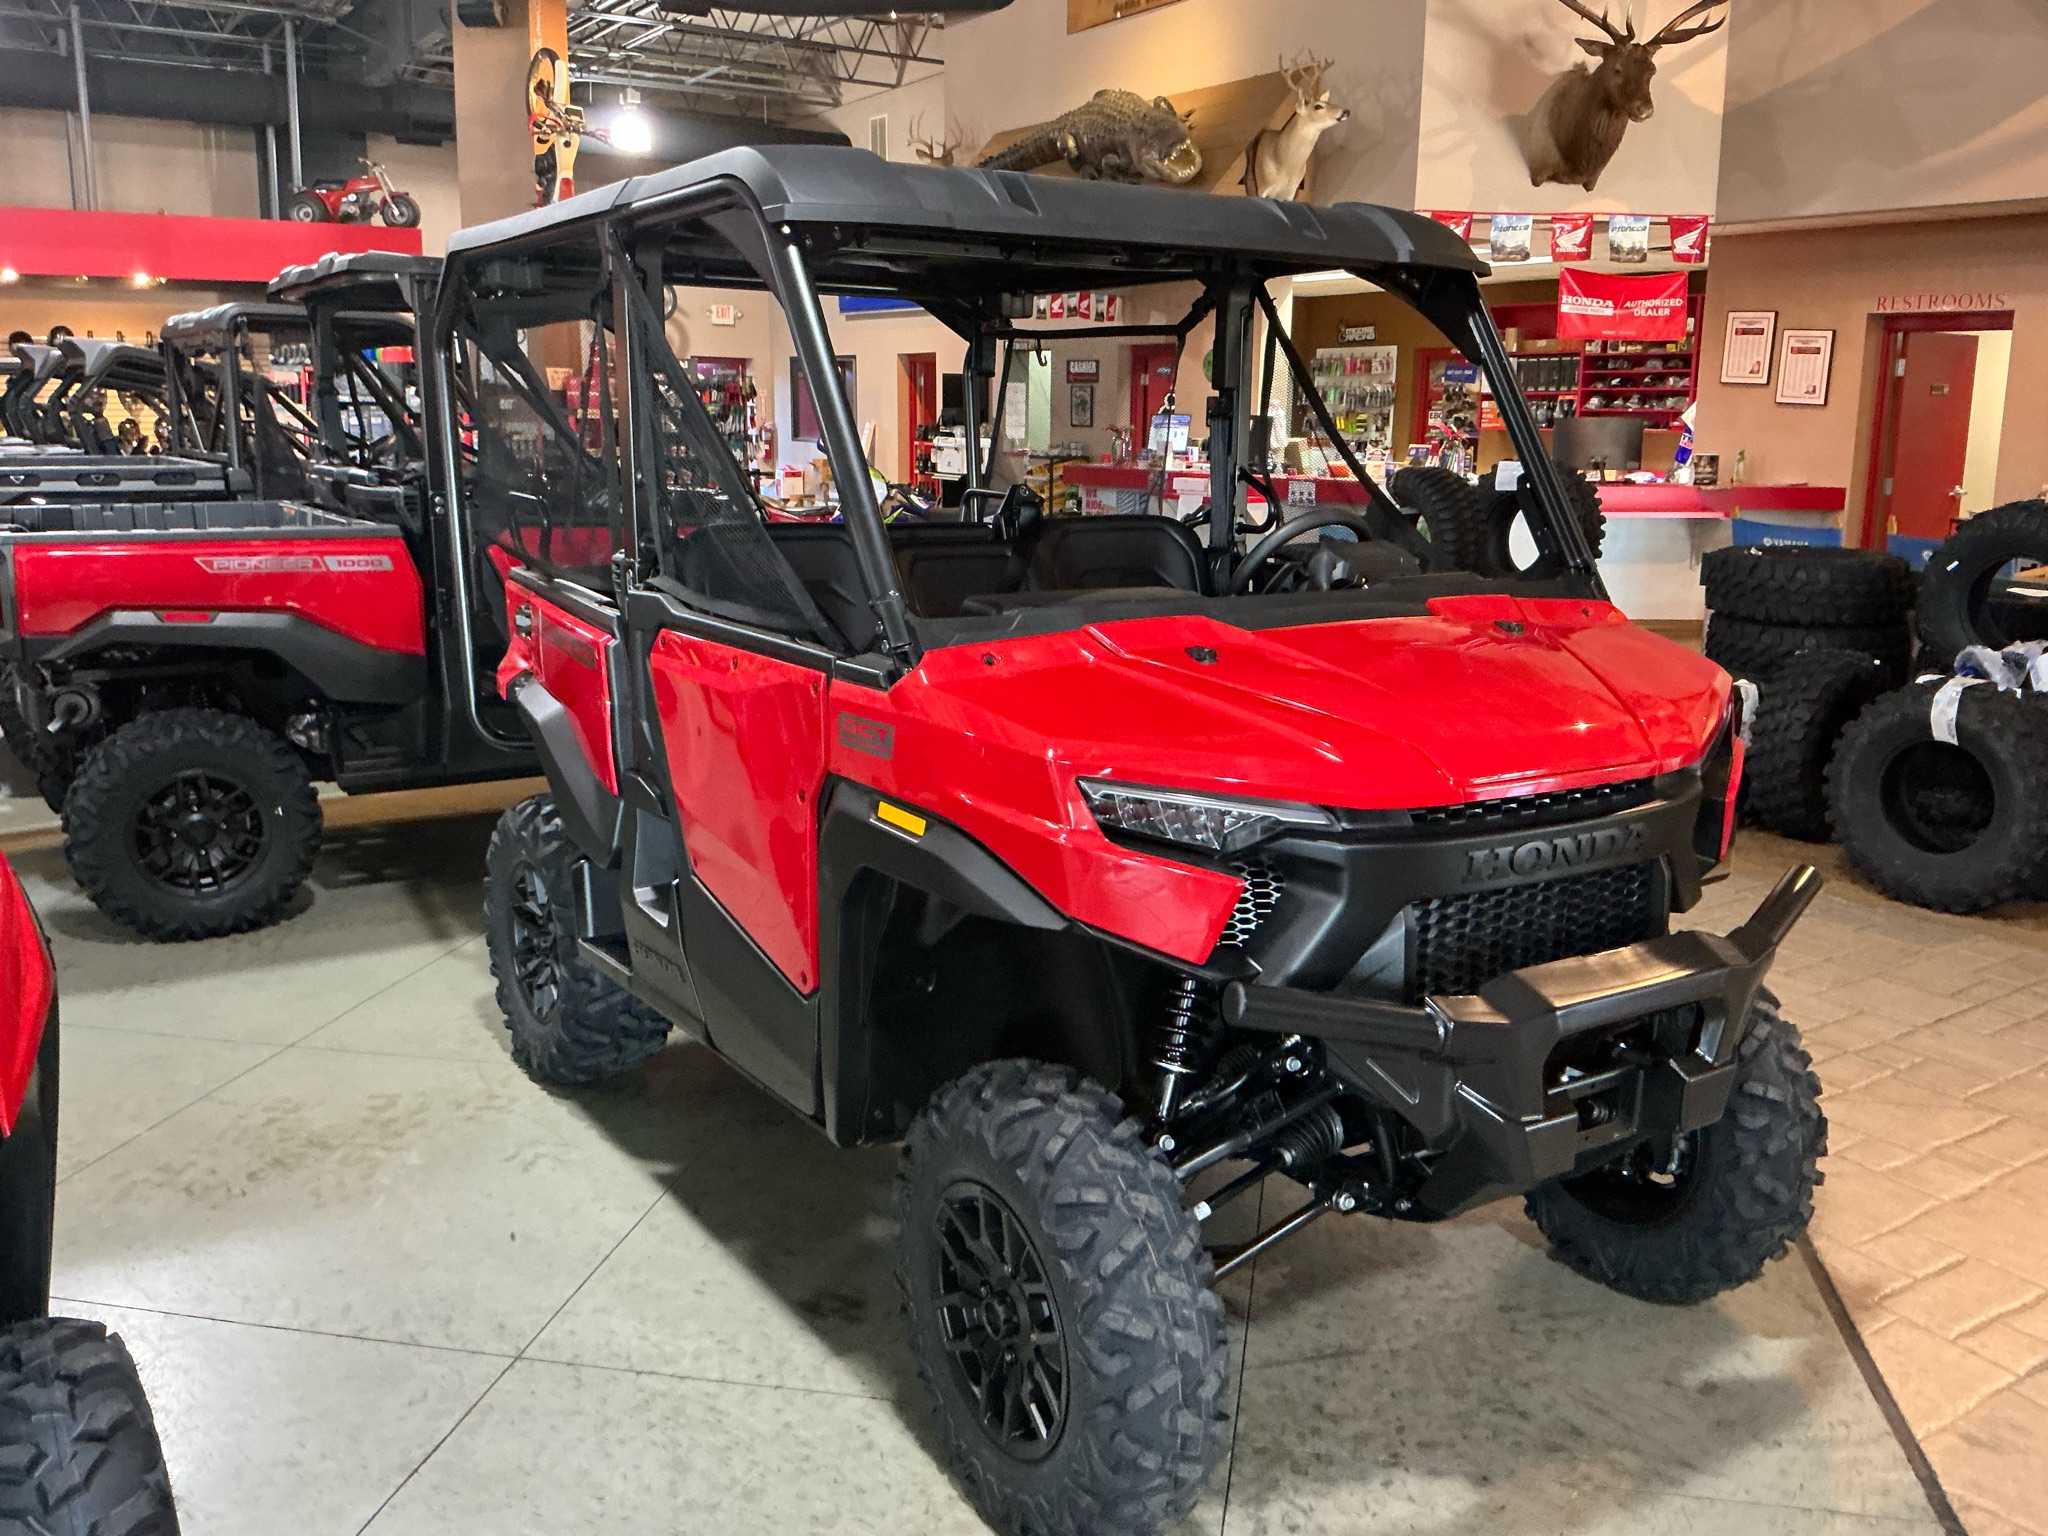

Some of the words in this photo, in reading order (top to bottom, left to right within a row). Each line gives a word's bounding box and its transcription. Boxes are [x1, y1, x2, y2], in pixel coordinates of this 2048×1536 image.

[1493, 224, 1530, 232] PIONEER
[1611, 225, 1647, 233] PIONEER
[1561, 295, 1615, 308] HONDA
[1623, 298, 1684, 308] AUTHORIZED
[1876, 292, 2007, 311] RESTROOMS
[716, 306, 731, 319] EXIT
[1633, 307, 1671, 317] DEALER
[1069, 361, 1097, 374] CASHIER
[213, 558, 314, 570] PIONEER
[336, 558, 383, 568] 1000
[842, 718, 890, 743] DCT
[1461, 823, 1647, 883] HONDA
